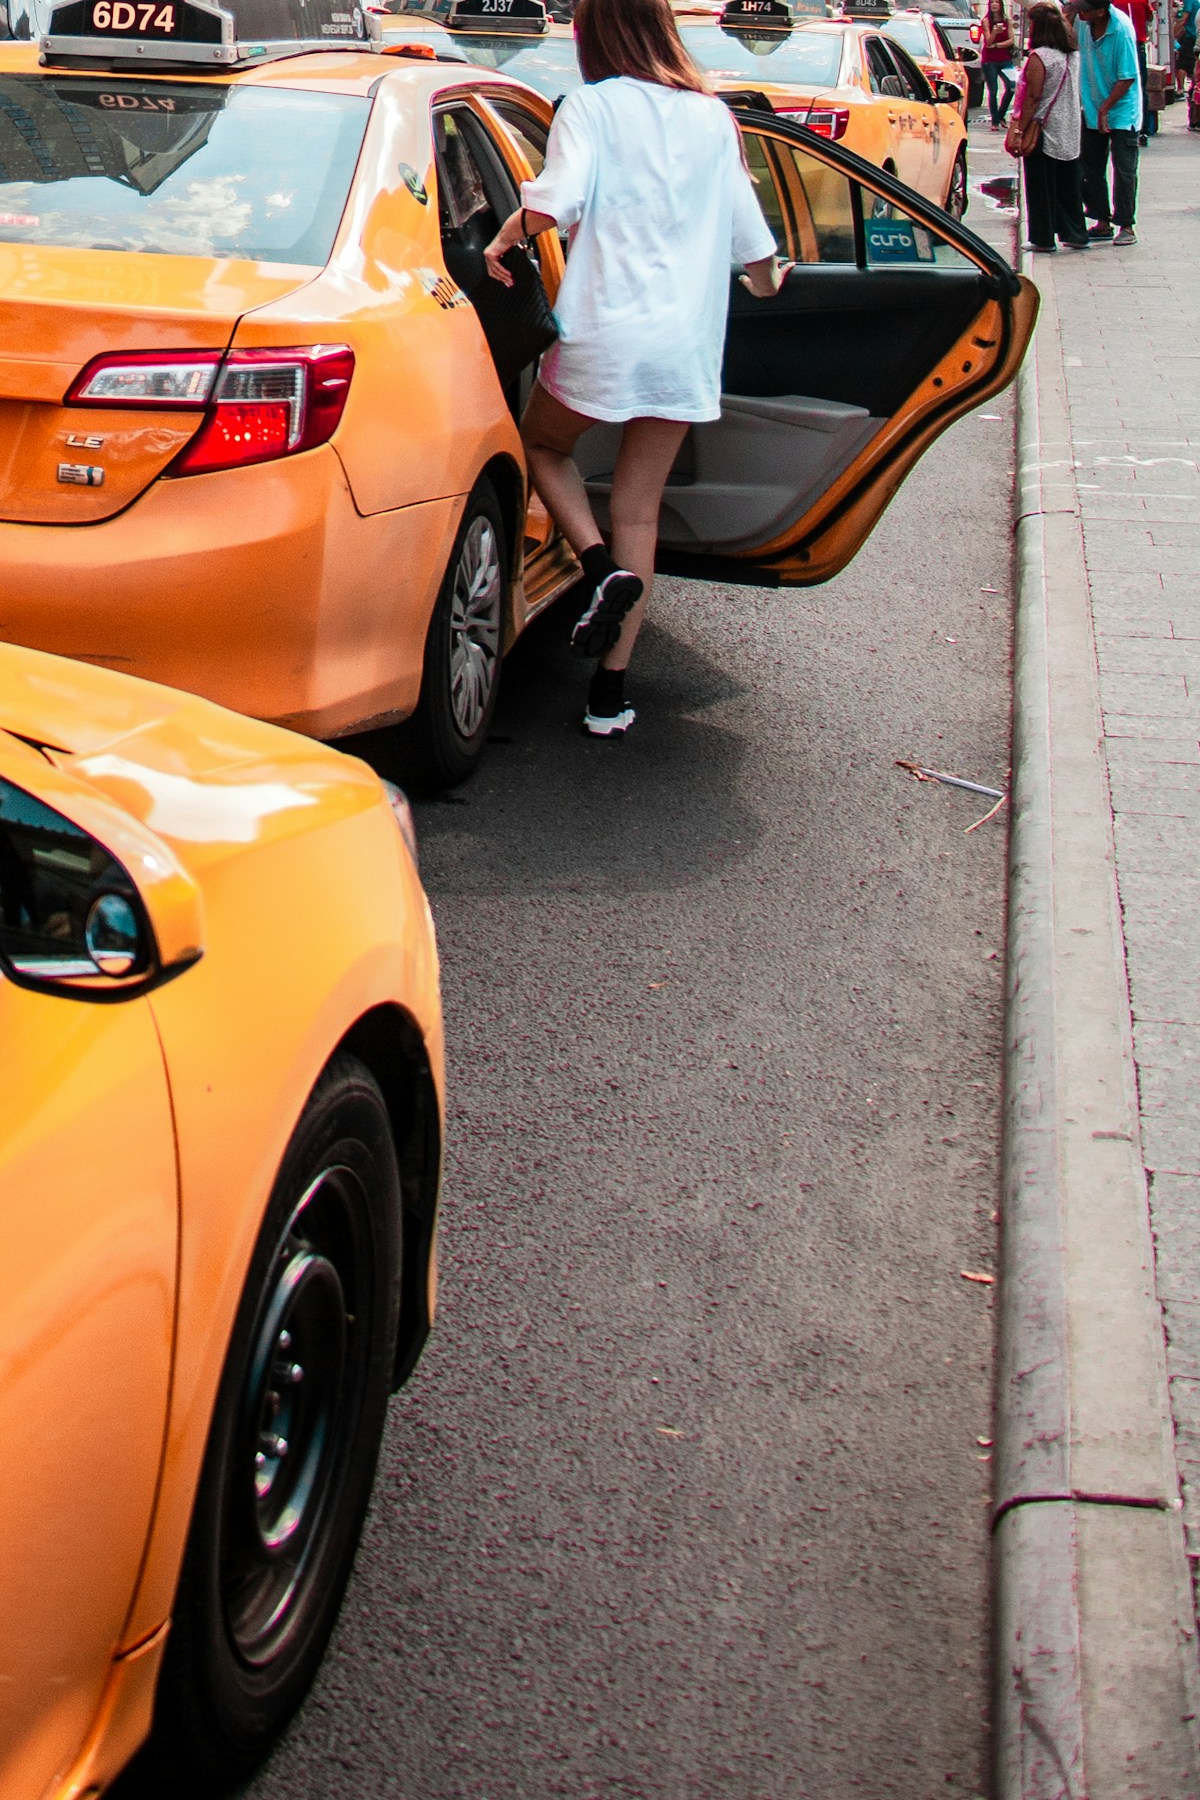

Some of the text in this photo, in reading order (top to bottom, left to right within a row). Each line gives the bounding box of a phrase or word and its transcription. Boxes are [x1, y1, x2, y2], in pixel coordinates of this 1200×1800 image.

[740, 0, 772, 13] 1H74
[92, 0, 175, 33] 6D74
[870, 232, 912, 247] curb
[66, 433, 104, 449] LE
